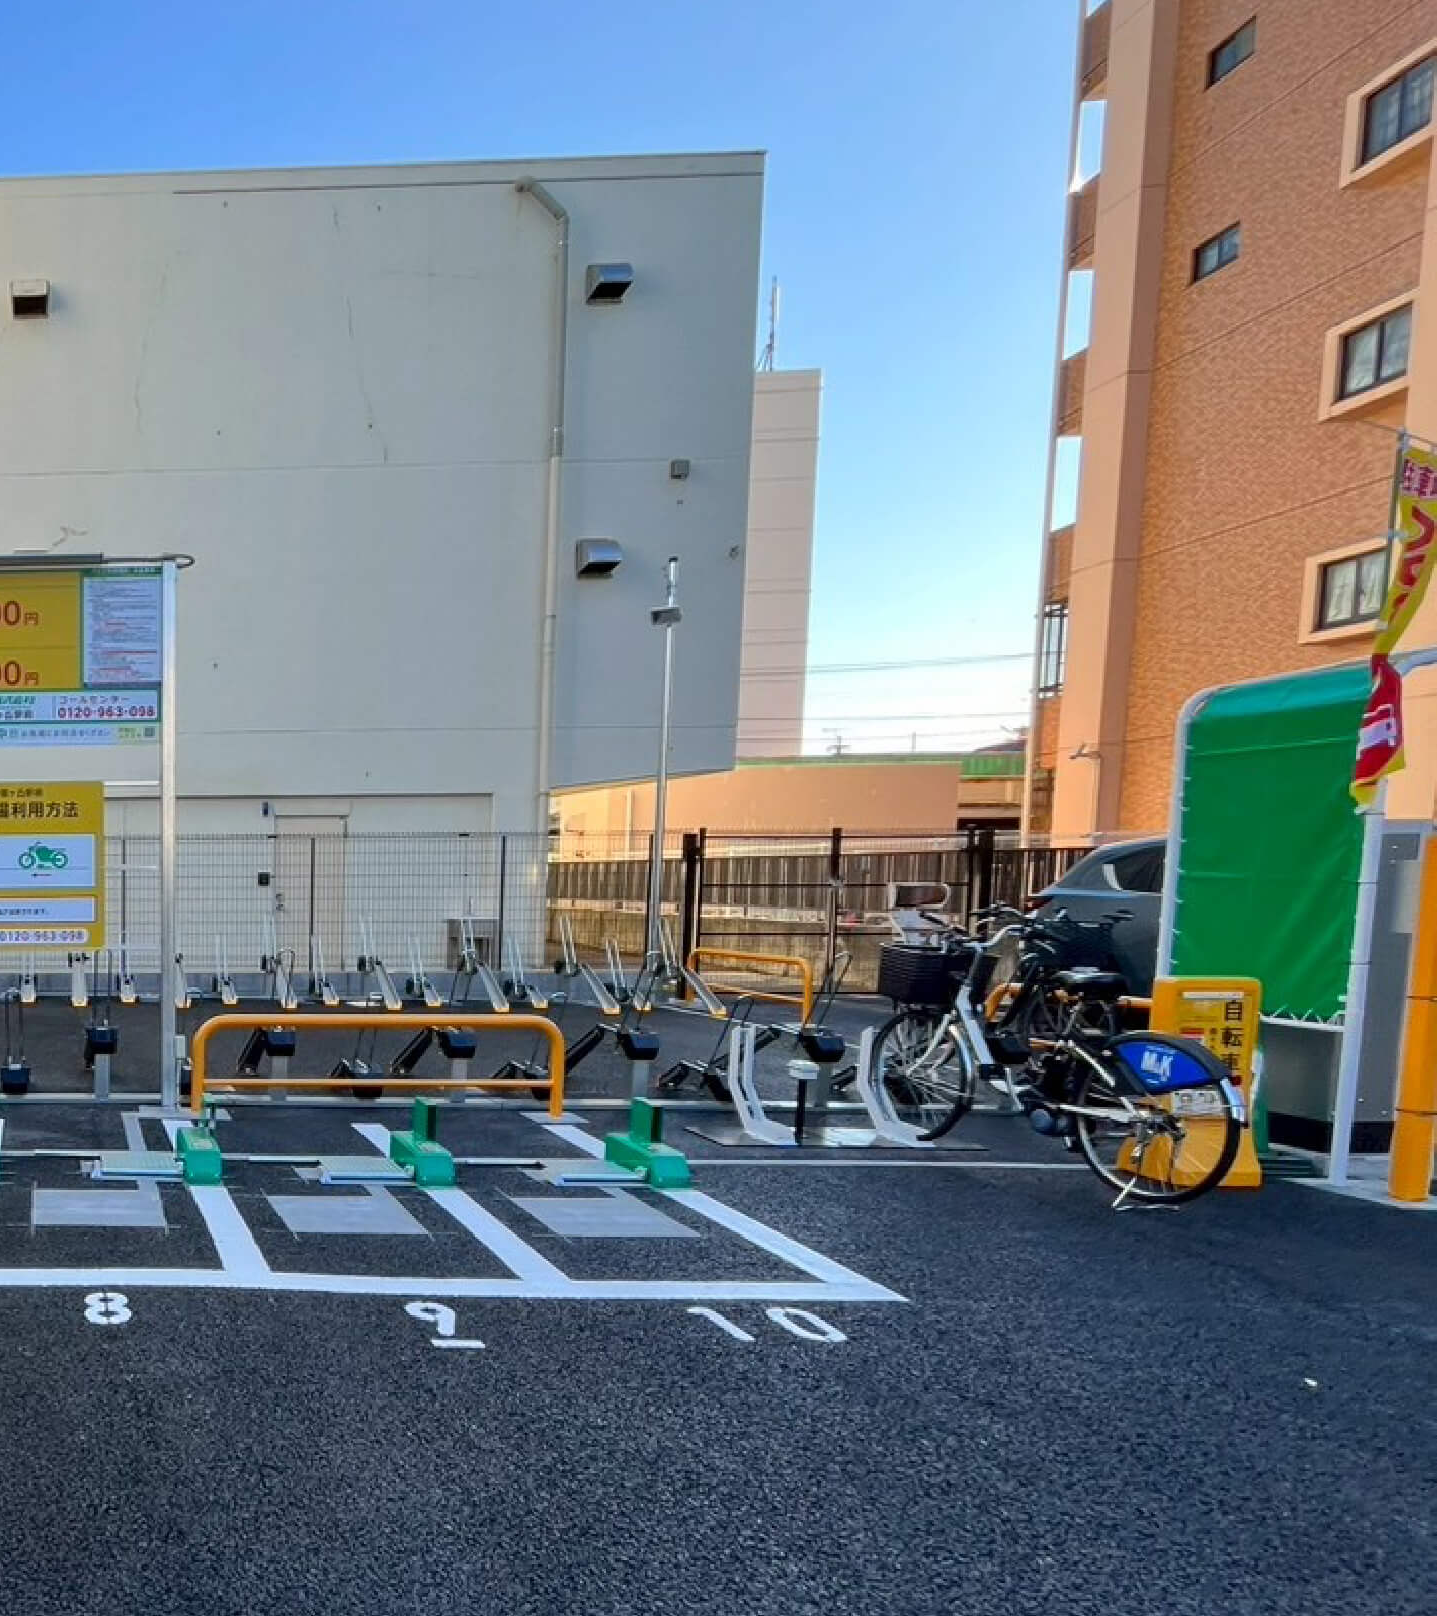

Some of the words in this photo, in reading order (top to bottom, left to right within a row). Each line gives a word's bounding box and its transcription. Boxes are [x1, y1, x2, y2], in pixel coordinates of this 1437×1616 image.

[59, 695, 131, 704] コールセンター
[84, 1292, 133, 1324] 8
[405, 1302, 456, 1336] 9
[686, 1306, 848, 1343] 10
